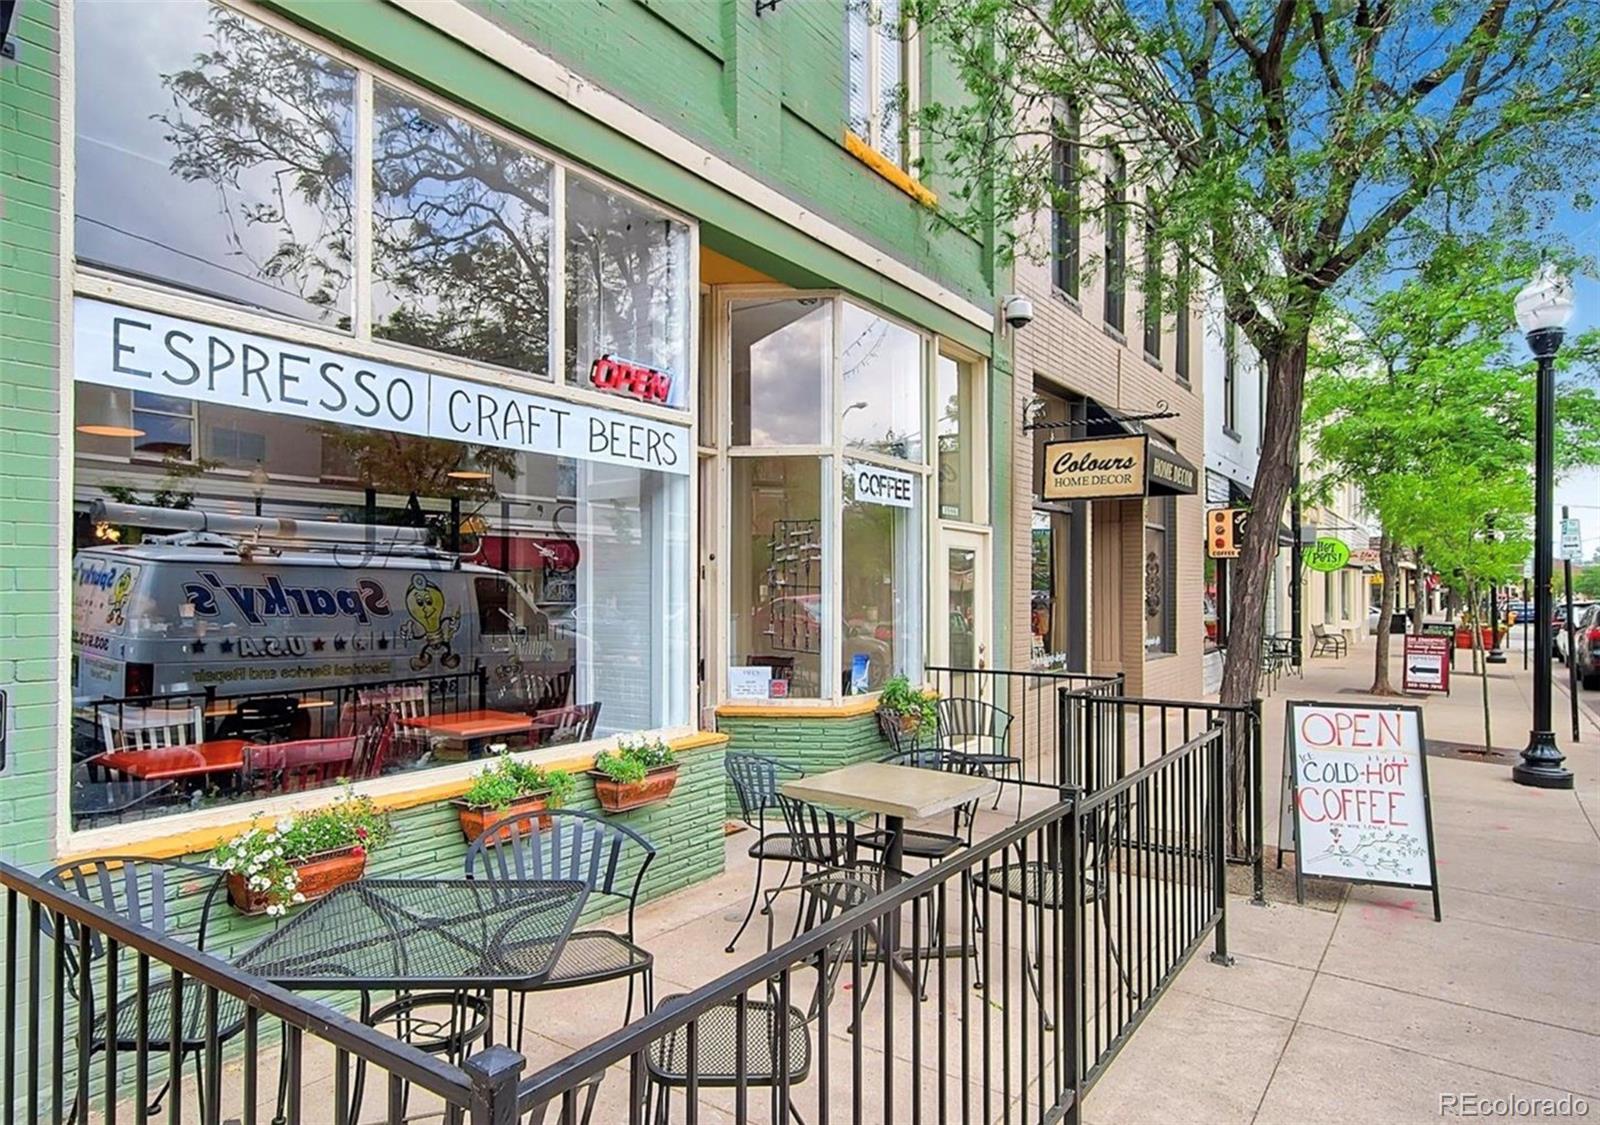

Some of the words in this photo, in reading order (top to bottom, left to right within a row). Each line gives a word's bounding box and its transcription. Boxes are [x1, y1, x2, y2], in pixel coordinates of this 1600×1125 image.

[112, 316, 414, 422] ESPRESSO
[449, 389, 570, 448] CRAFT
[588, 416, 677, 466] BEERS
[594, 359, 671, 402] OPEN
[1053, 452, 1136, 475] Colours
[1153, 457, 1173, 481] HOME
[858, 471, 911, 501] COFFEE
[1054, 477, 1089, 488] HOME
[1091, 474, 1133, 485] DECOR
[1302, 712, 1402, 747] OPEN
[1299, 787, 1409, 827] COFFEE
